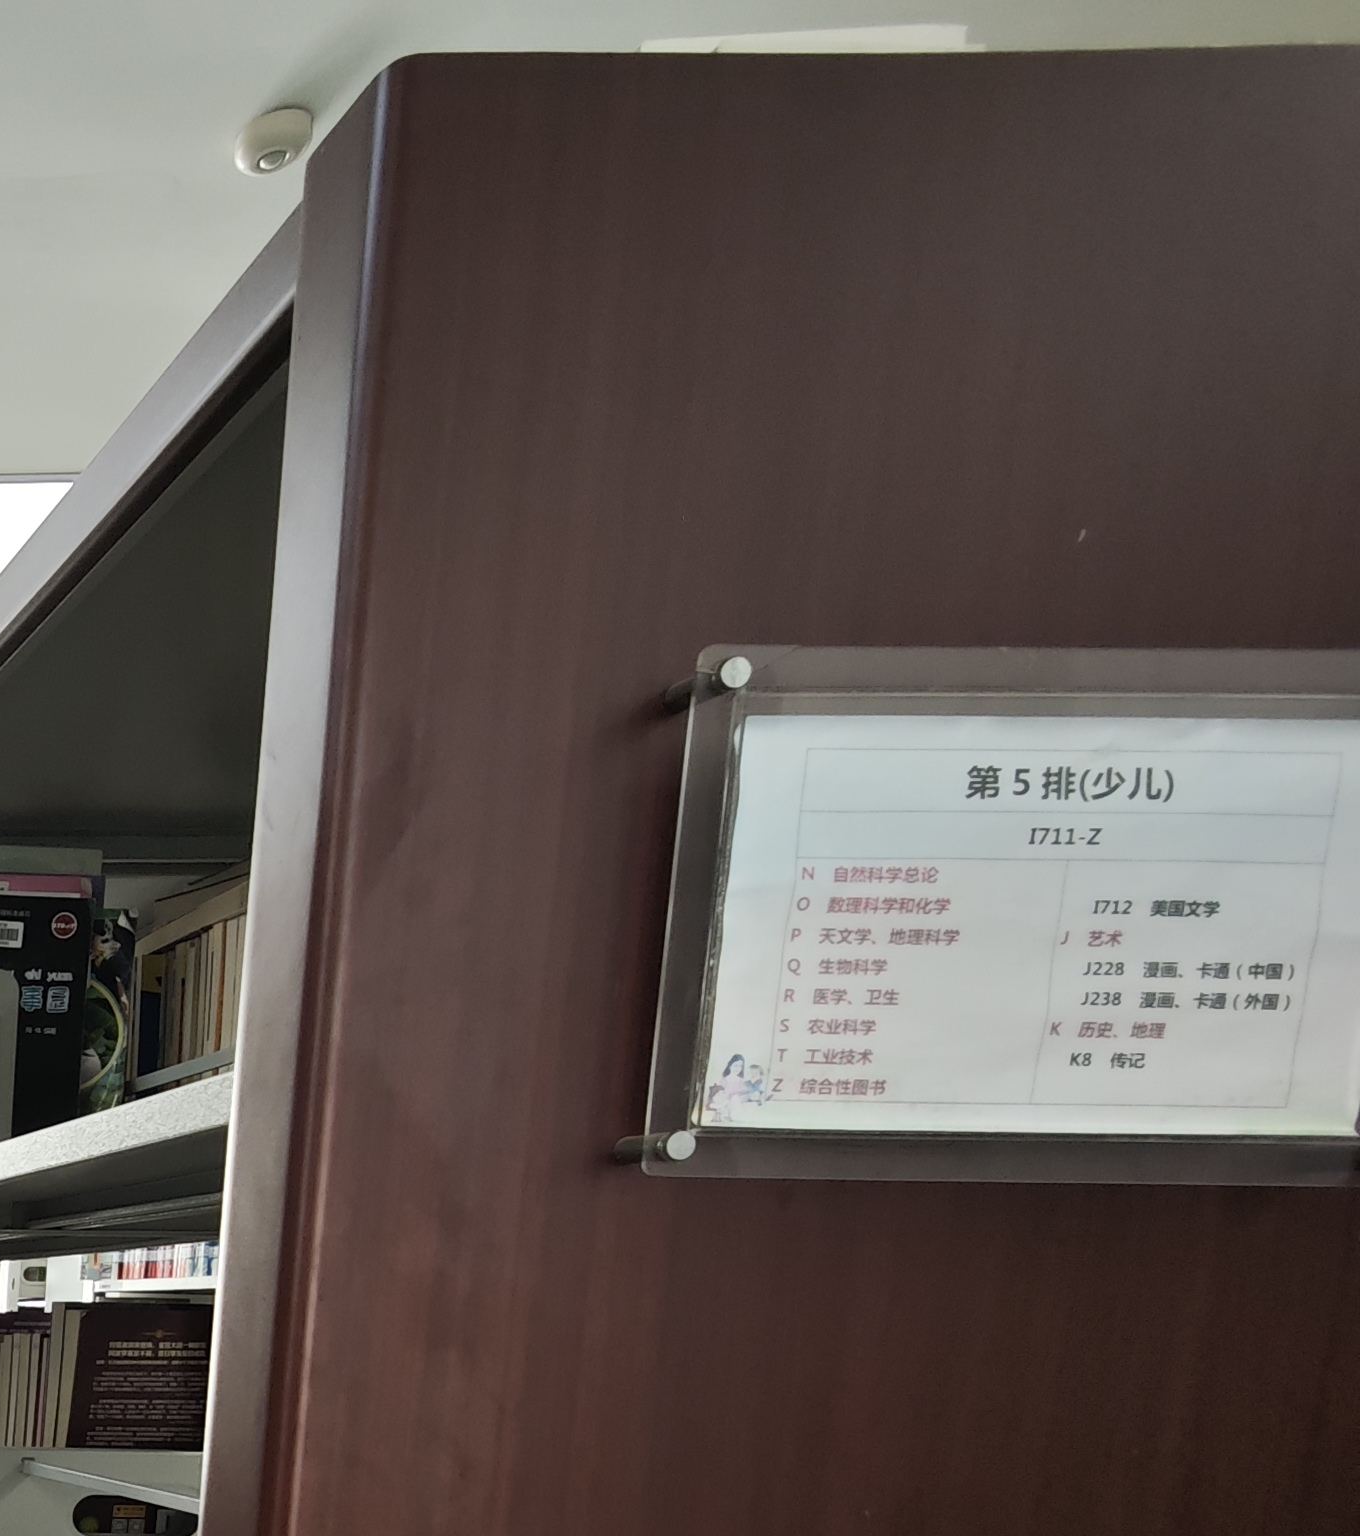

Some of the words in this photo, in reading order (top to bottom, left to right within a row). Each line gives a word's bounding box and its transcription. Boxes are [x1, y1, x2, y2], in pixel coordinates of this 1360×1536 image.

[966, 766, 1002, 799] 第
[1013, 769, 1030, 795] 5
[802, 867, 814, 880] N
[834, 867, 939, 883] 自然科学总论
[827, 897, 951, 915] 数理科学和化学
[1150, 900, 1220, 918] 美国文学
[791, 928, 801, 941] P
[819, 928, 960, 946] 天文学、地理科学
[1060, 931, 1069, 945] J
[1088, 930, 1123, 947] 艺术
[787, 959, 800, 976] Q
[819, 958, 888, 976] 生物科学
[1083, 962, 1124, 975] J228
[784, 989, 795, 1002] R
[813, 989, 899, 1005] 医学、卫生
[1081, 992, 1121, 1006] J238
[780, 1019, 789, 1032] S
[808, 1019, 876, 1035] 农业科学
[1050, 1022, 1062, 1036] K
[1078, 1022, 1166, 1039] 历史、地理
[777, 1049, 788, 1062] T
[804, 1049, 873, 1065] 工业技术
[1070, 1053, 1092, 1066] K8
[1111, 1053, 1145, 1068] 传记
[772, 1078, 783, 1092] Z
[800, 1078, 887, 1096] 综合性图书
